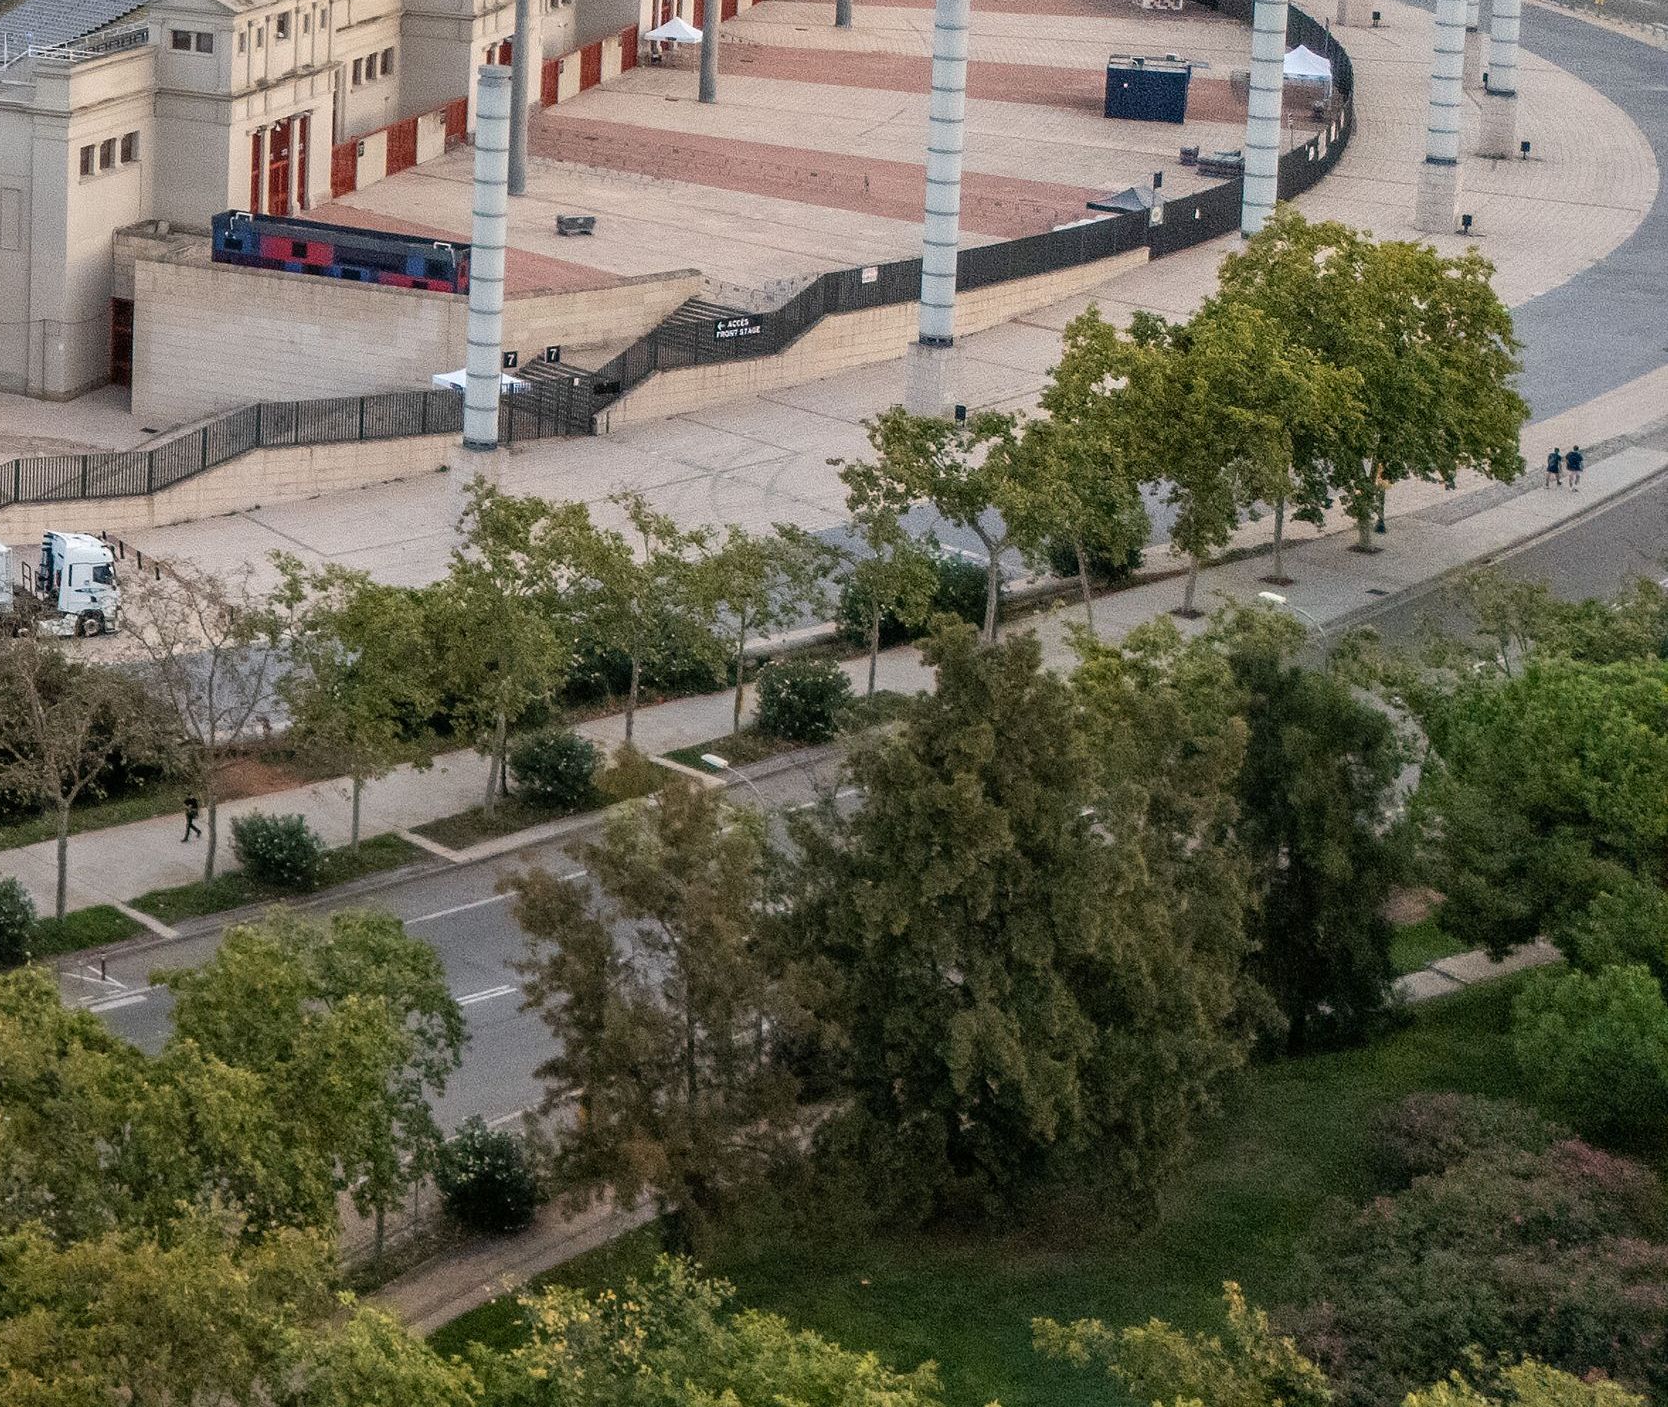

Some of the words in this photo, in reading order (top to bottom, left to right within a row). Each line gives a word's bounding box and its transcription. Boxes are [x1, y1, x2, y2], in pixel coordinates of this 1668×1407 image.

[716, 328, 738, 339] FRONT
[739, 325, 761, 336] STAGE
[508, 354, 515, 366] 7
[549, 348, 557, 361] 7
